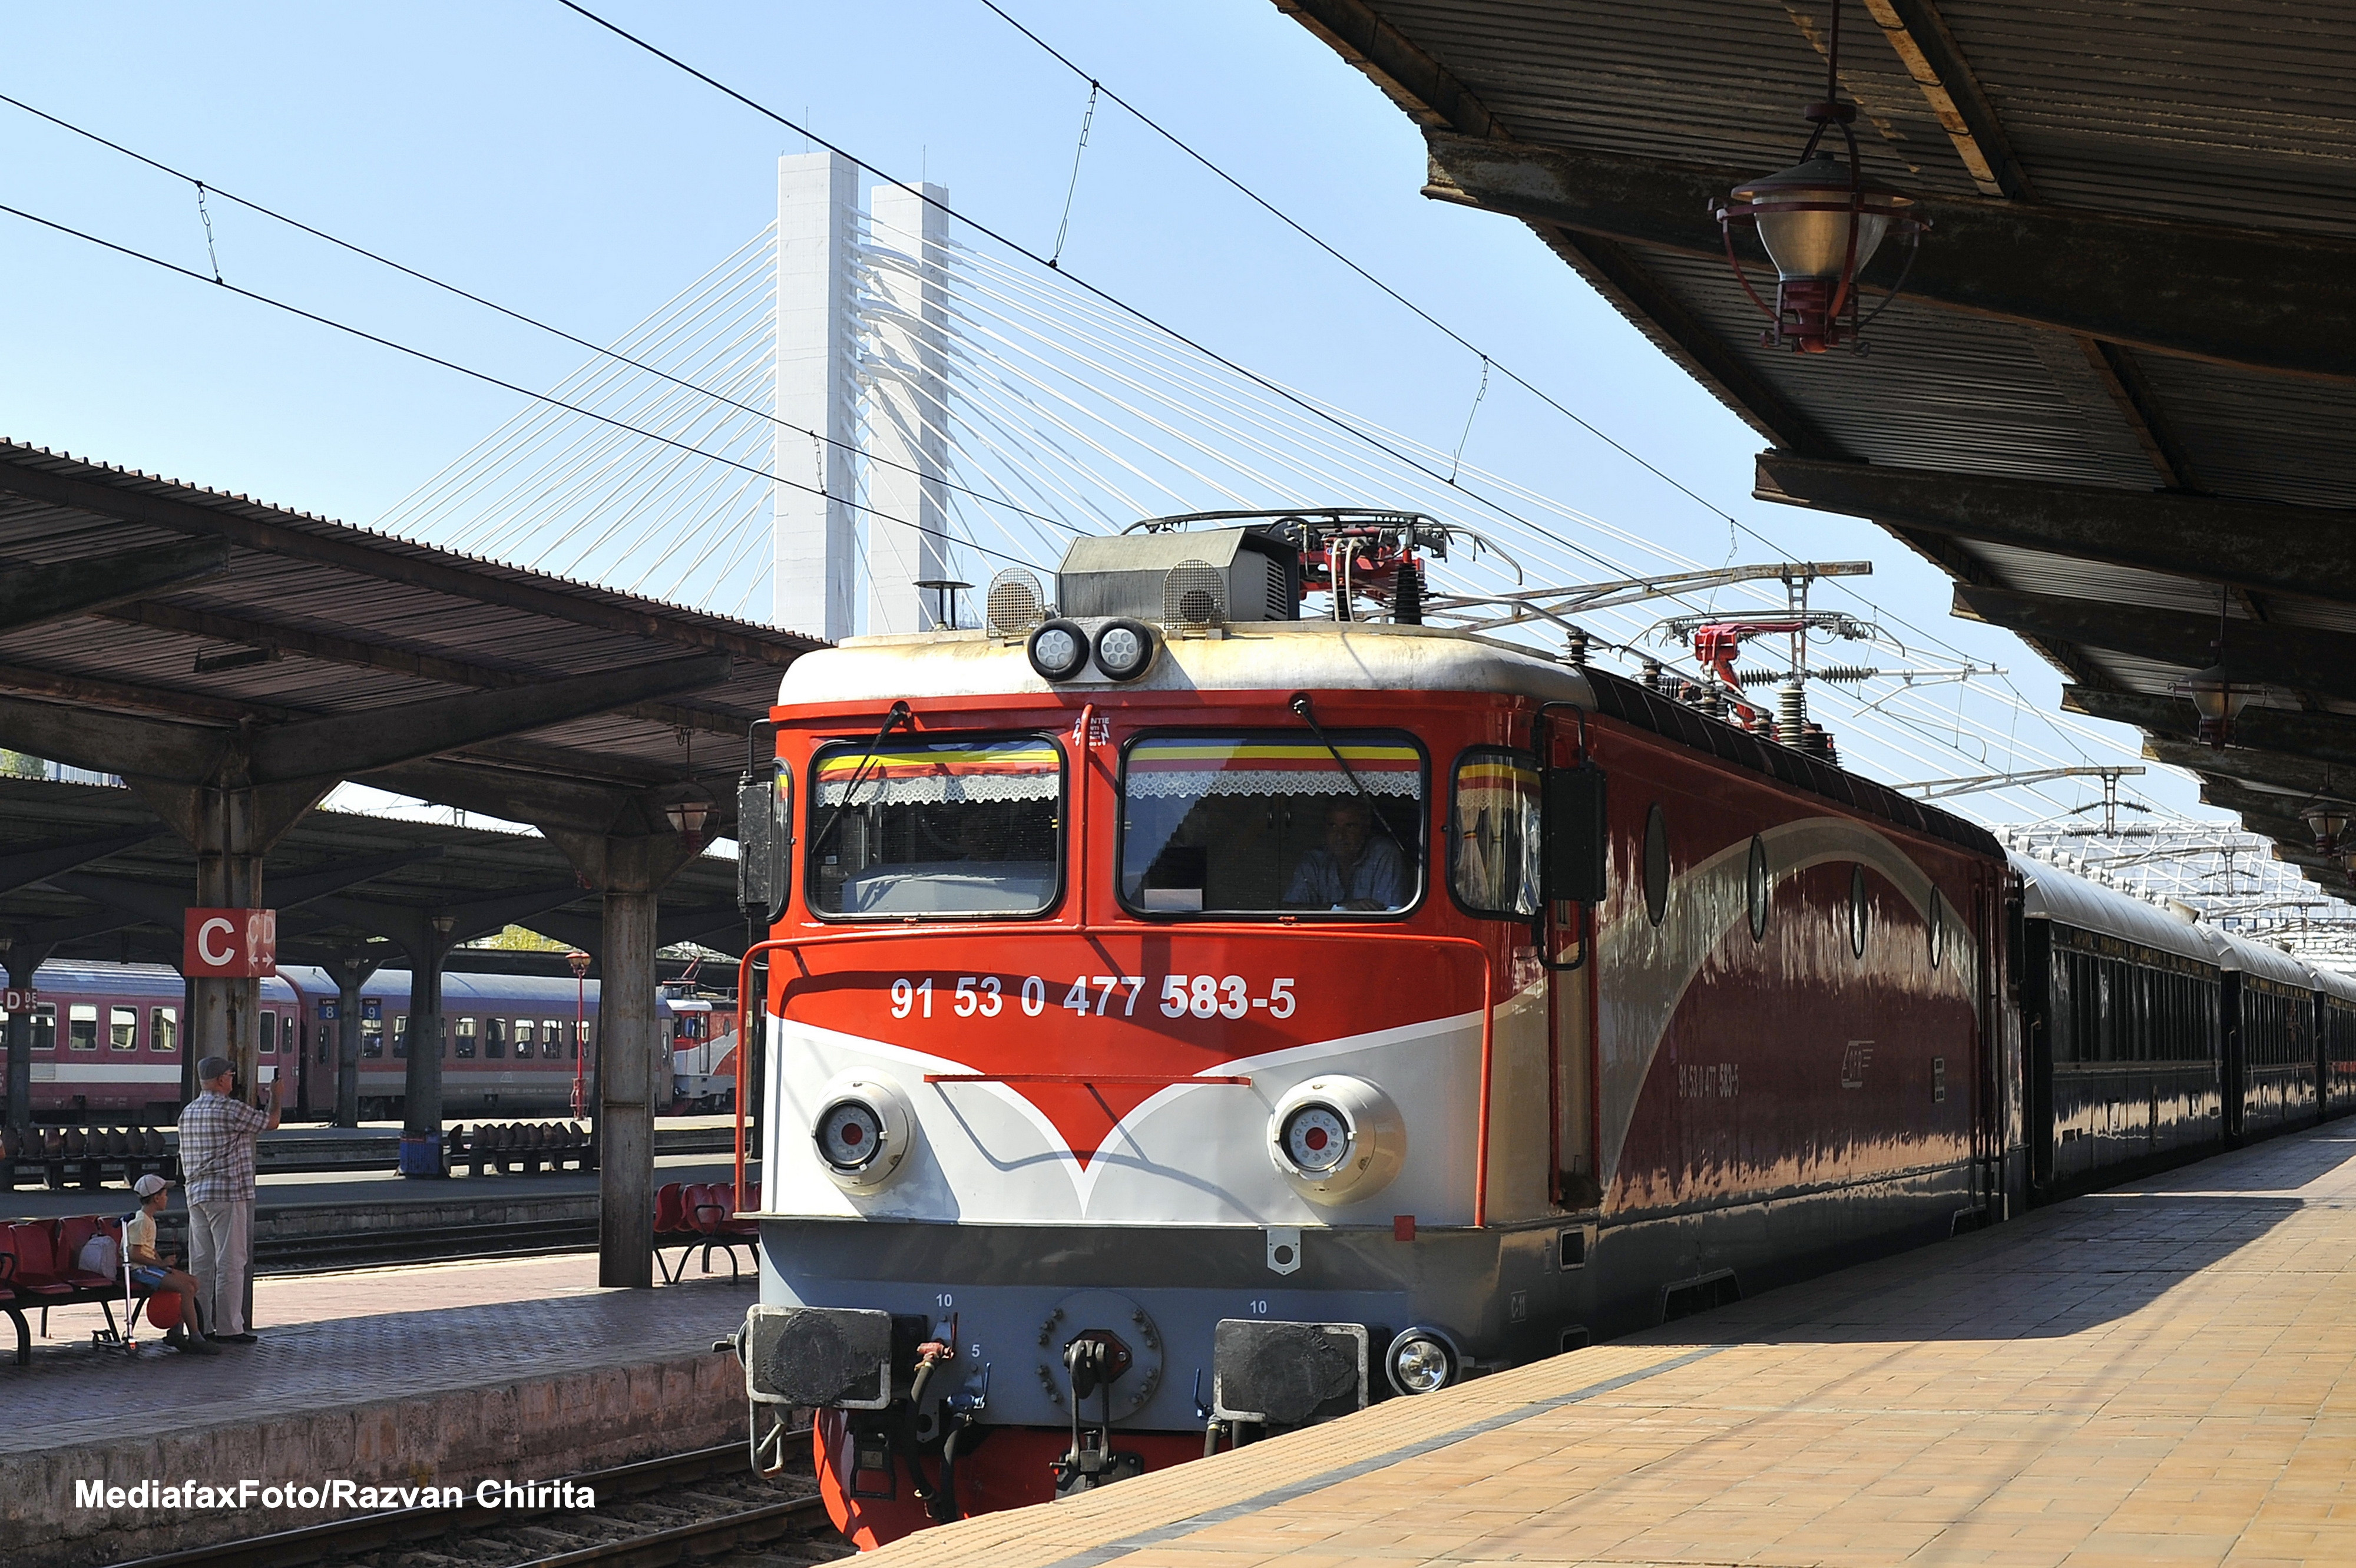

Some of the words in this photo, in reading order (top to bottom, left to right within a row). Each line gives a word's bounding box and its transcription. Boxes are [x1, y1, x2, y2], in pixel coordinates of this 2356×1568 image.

[248, 915, 259, 944] C
[263, 915, 274, 944] D
[198, 918, 235, 966] C
[7, 991, 20, 1009] D
[891, 978, 932, 1018] 91
[954, 977, 1003, 1017] 53
[1021, 975, 1045, 1017] 0
[1063, 975, 1146, 1017] 477
[1160, 975, 1296, 1020] 583-5
[326, 1006, 334, 1018] 8
[368, 1007, 375, 1018] 9
[1679, 1063, 1687, 1097] 91
[1689, 1064, 1697, 1098] 53
[1705, 1066, 1716, 1098] 477
[1720, 1063, 1739, 1098] 583-5
[936, 1294, 952, 1307] 10
[1250, 1301, 1267, 1314] 10
[971, 1345, 980, 1357] 5
